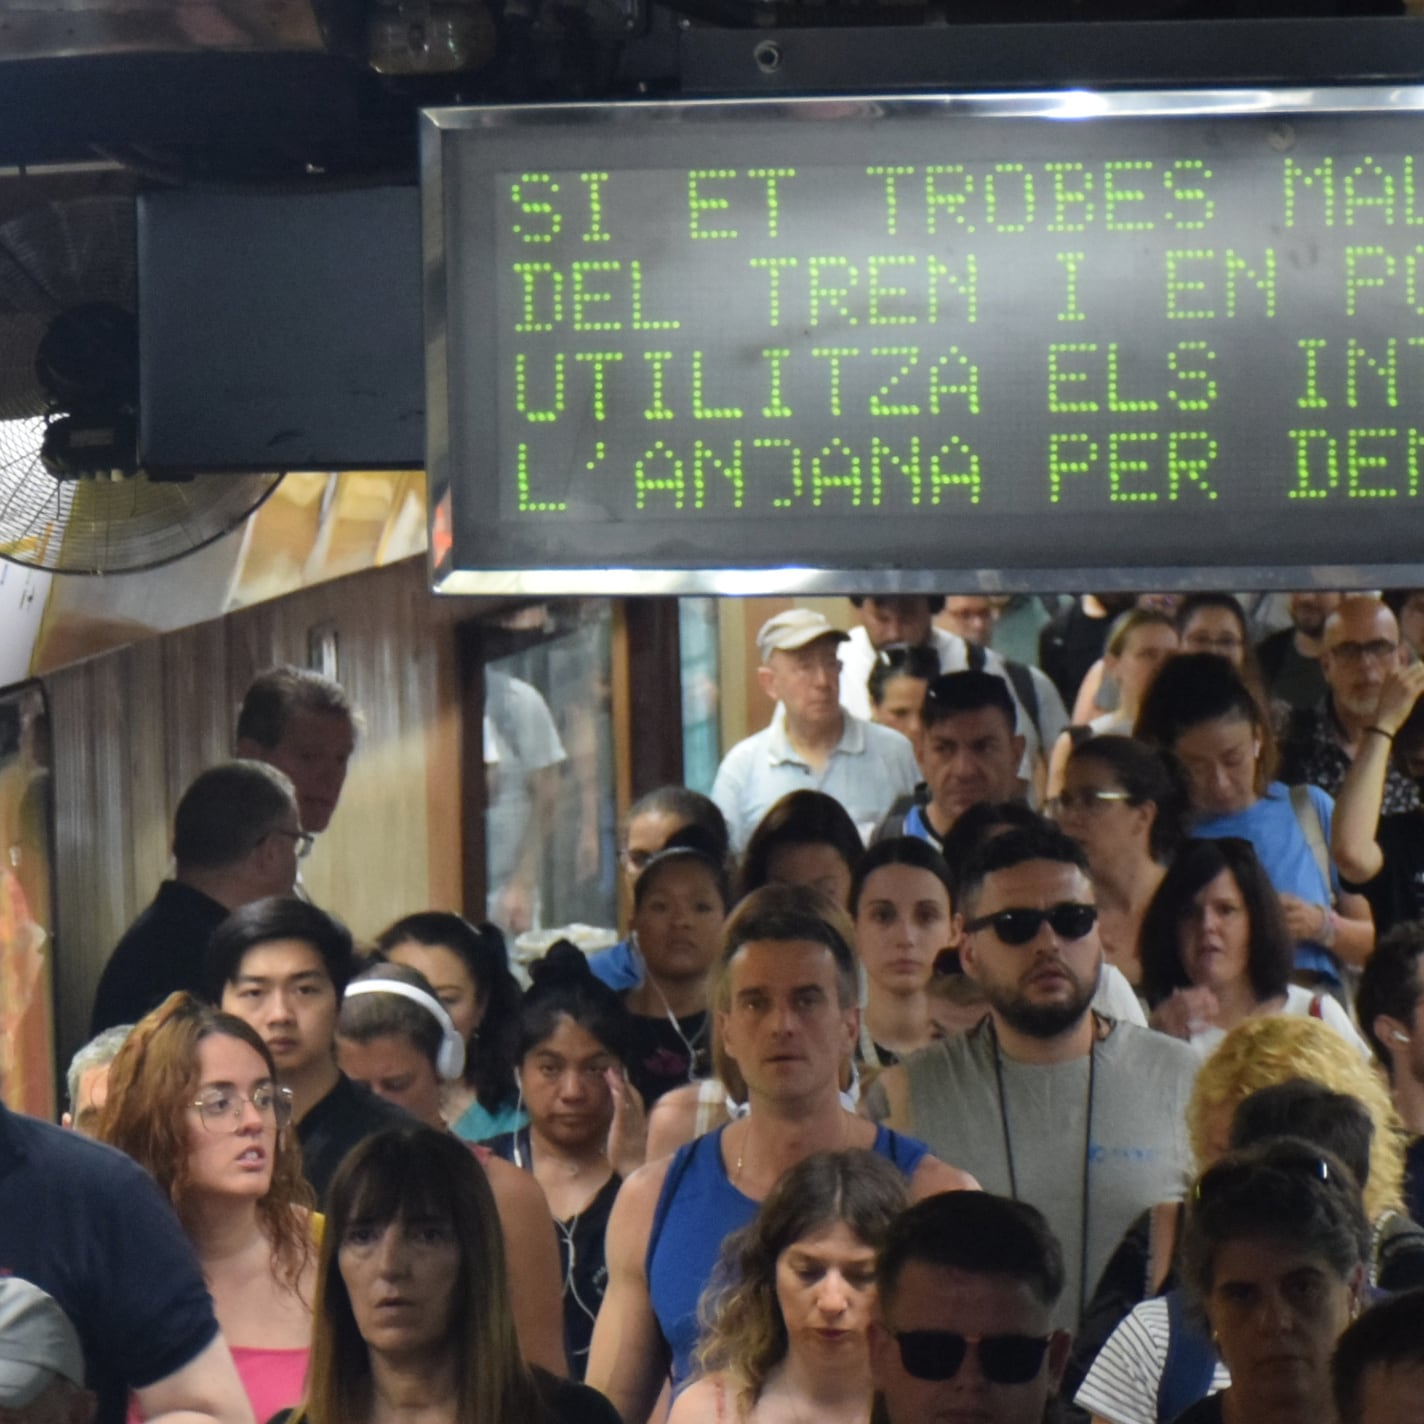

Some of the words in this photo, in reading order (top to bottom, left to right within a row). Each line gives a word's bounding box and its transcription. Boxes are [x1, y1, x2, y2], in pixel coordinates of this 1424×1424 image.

[510, 172, 611, 244] SI
[688, 168, 796, 239] ET
[866, 159, 1214, 232] TROBES
[512, 260, 680, 333] DEL
[750, 253, 977, 325] TREN
[1057, 250, 1086, 322] I
[1166, 248, 1277, 320] EN
[515, 346, 980, 423] UTILITZA
[1047, 341, 1218, 414] ELS
[1048, 430, 1219, 504] PER
